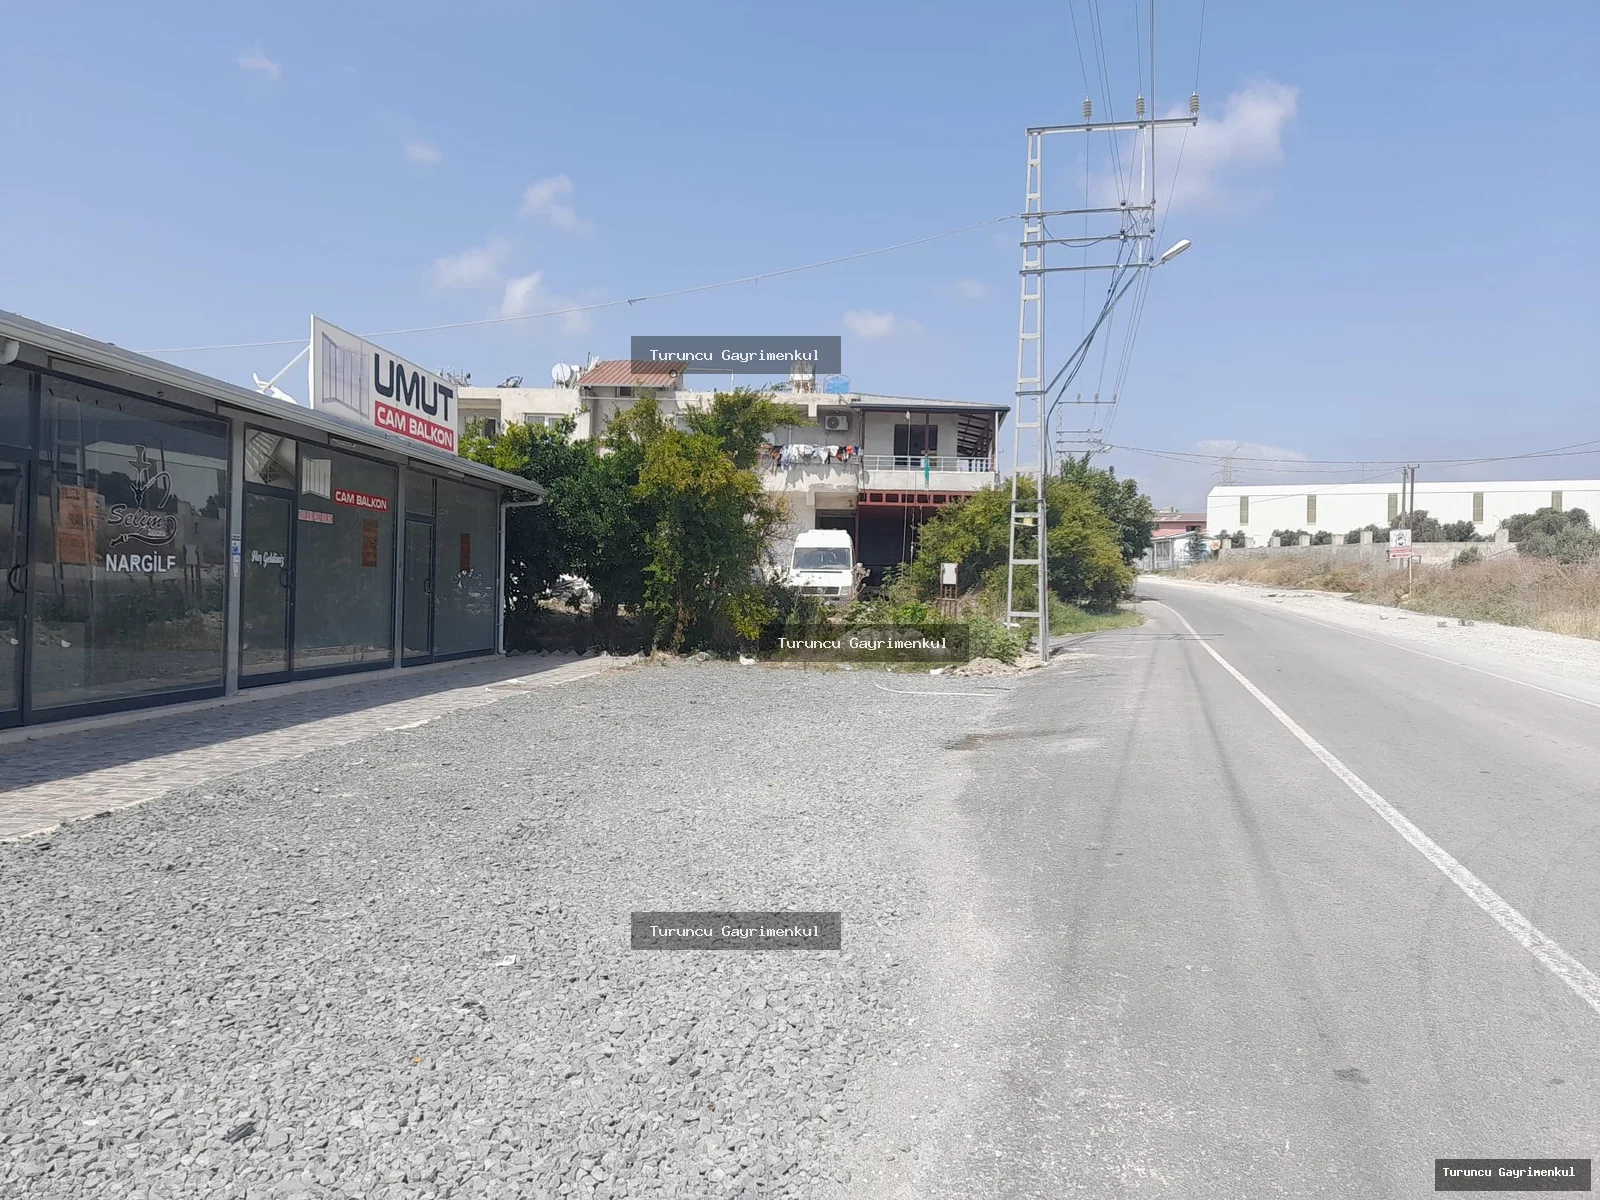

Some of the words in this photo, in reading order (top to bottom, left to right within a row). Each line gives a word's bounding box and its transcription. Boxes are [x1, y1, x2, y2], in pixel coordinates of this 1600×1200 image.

[374, 352, 454, 422] UMUT
[376, 405, 407, 432] CAM
[409, 419, 453, 448] BALKON
[107, 503, 165, 528] Selim
[335, 490, 355, 504] CAM
[356, 494, 387, 510] BALKON
